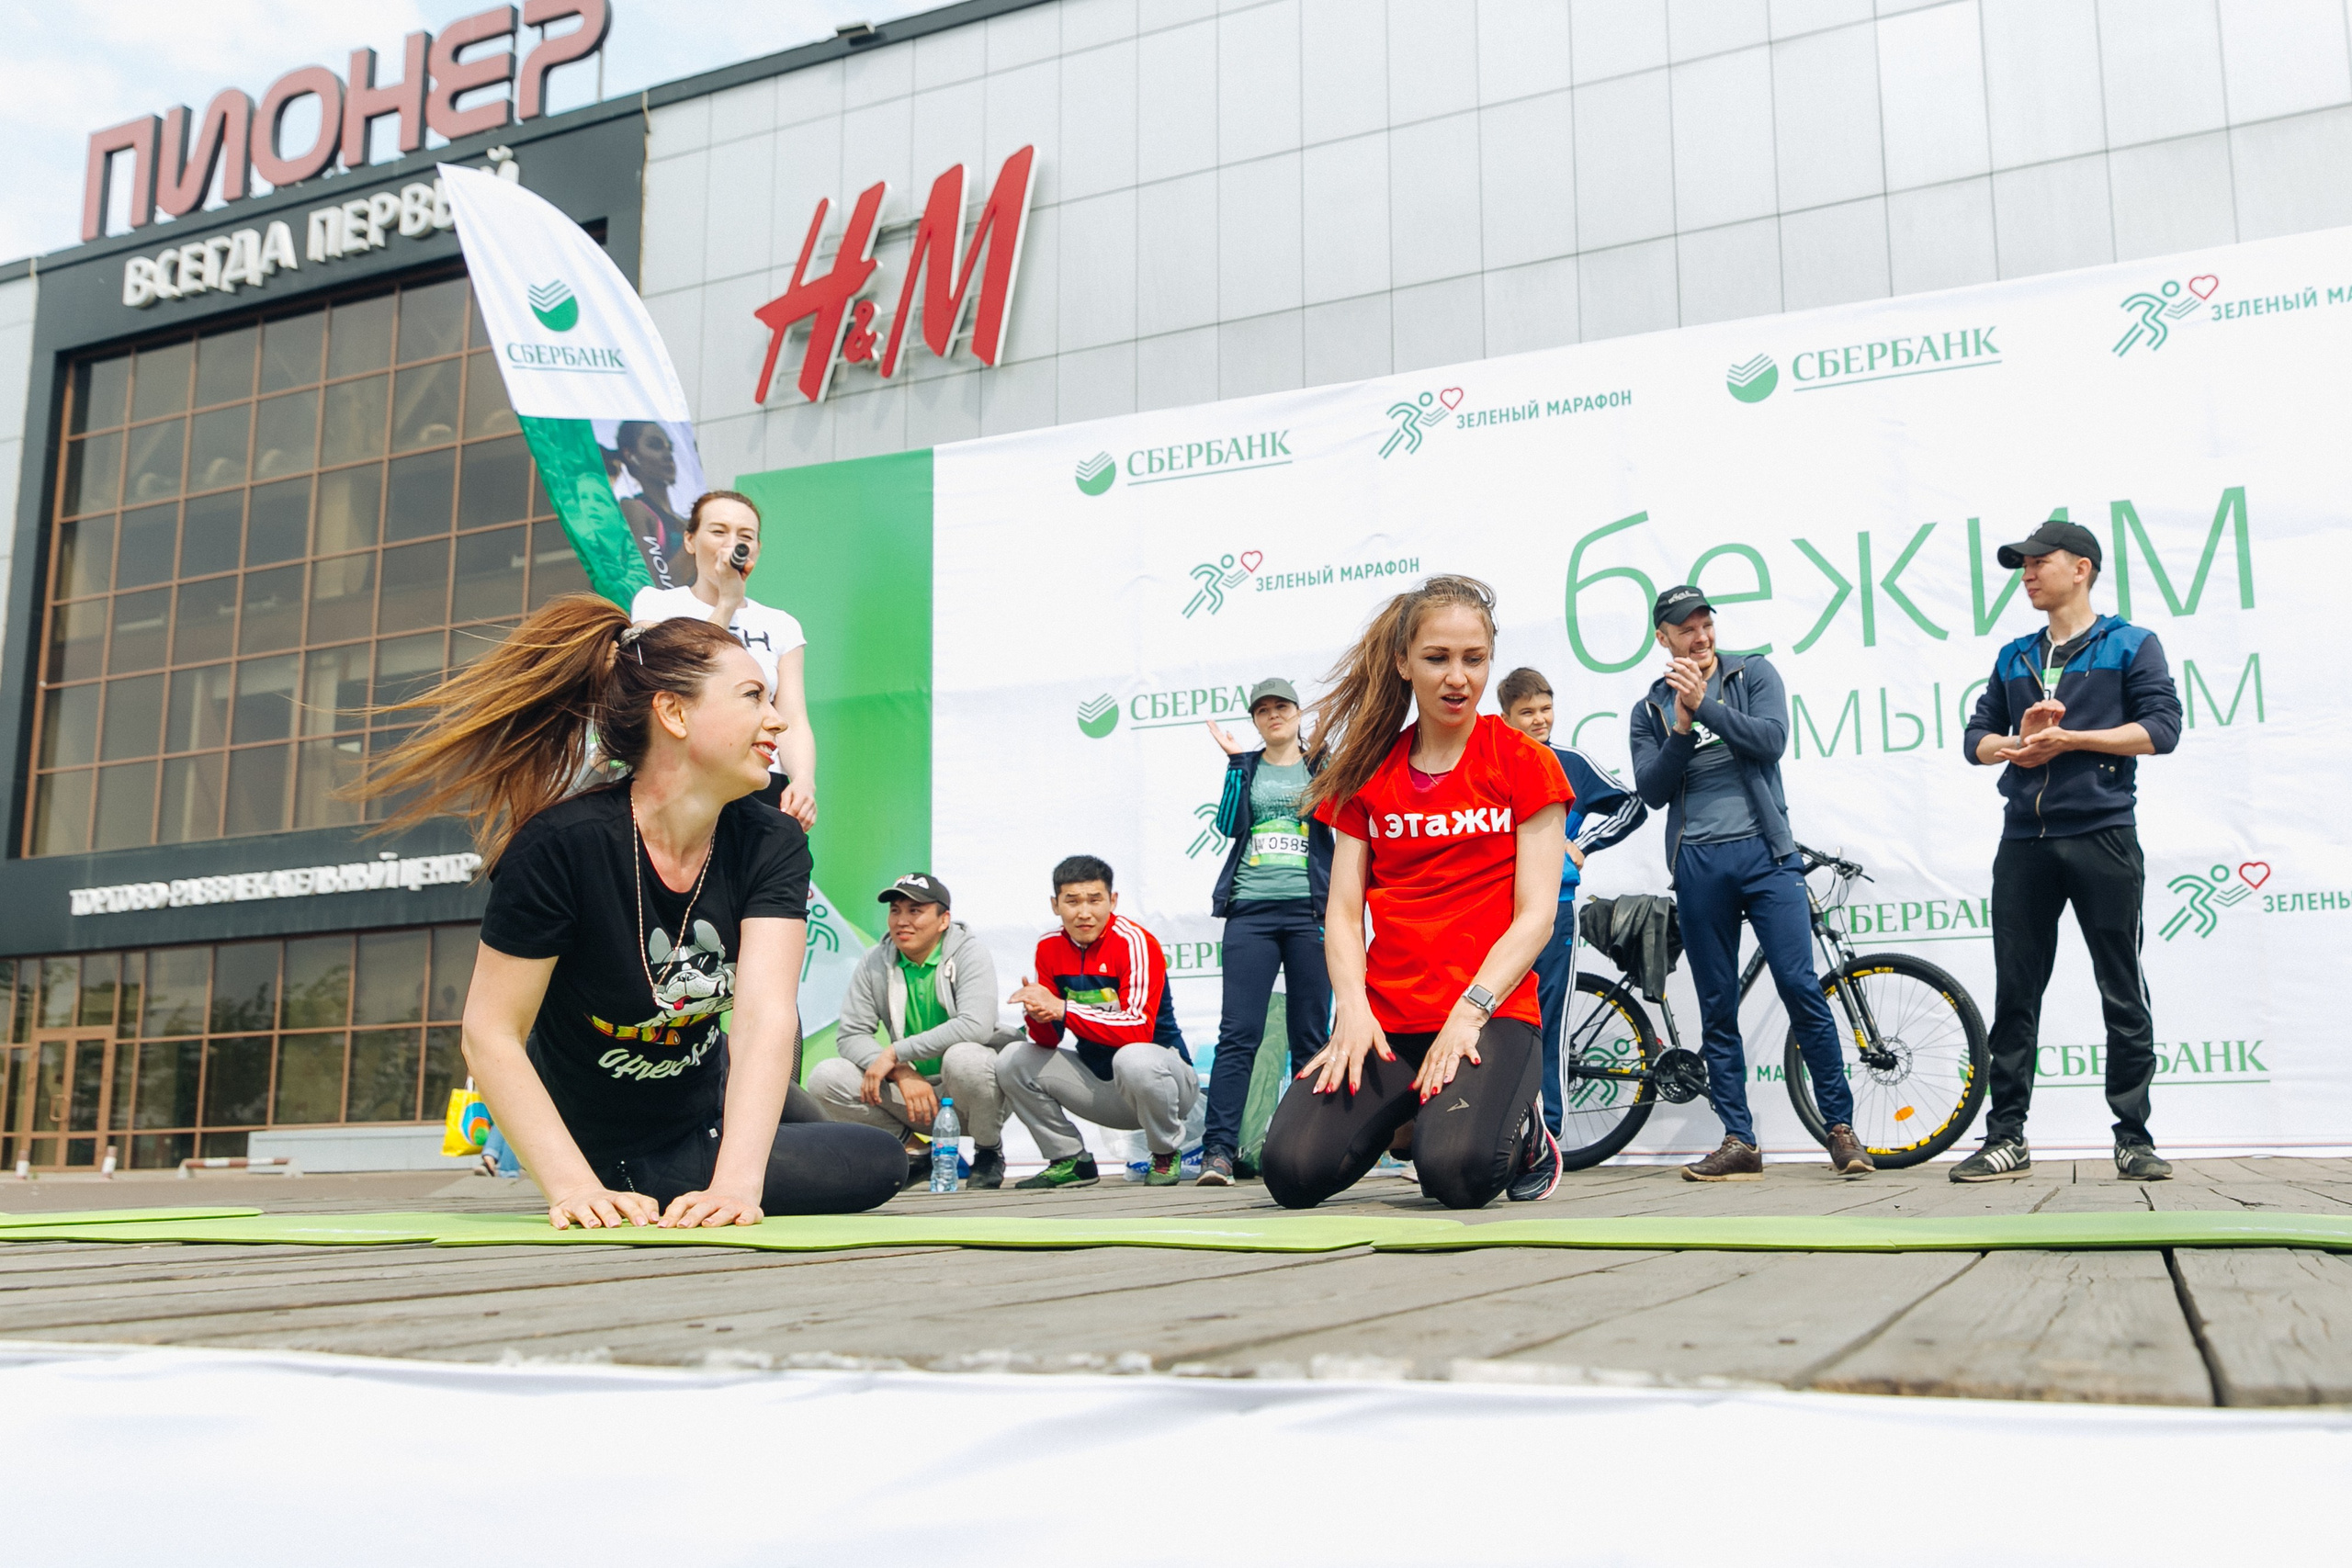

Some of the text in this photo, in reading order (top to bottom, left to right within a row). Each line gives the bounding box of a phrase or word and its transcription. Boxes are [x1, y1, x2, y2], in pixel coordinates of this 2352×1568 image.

[83, 0, 612, 242] ПИОНЕР
[122, 144, 520, 308] ВСЕГДА ПЕРВ
[754, 144, 1039, 405] H&M
[2211, 286, 2318, 321] ЗЕЛЕНЫЙ
[506, 343, 625, 367] СБЕРБАНК
[1792, 326, 2001, 382] СБЕРБАНК
[1456, 389, 1633, 430] ЗЕЛЕНЫЙ МАРАФОН
[1126, 430, 1293, 478] СБЕРБАНК
[1255, 557, 1420, 592] ЗЕЛЕНЫЙ МАРАФОН
[1130, 680, 1295, 721] СБЕРБА
[1823, 897, 1992, 935] СБЕРБА
[2263, 891, 2352, 913] ЗЕЛЕНЫ
[2034, 1040, 2269, 1077] СБЕБАНК
